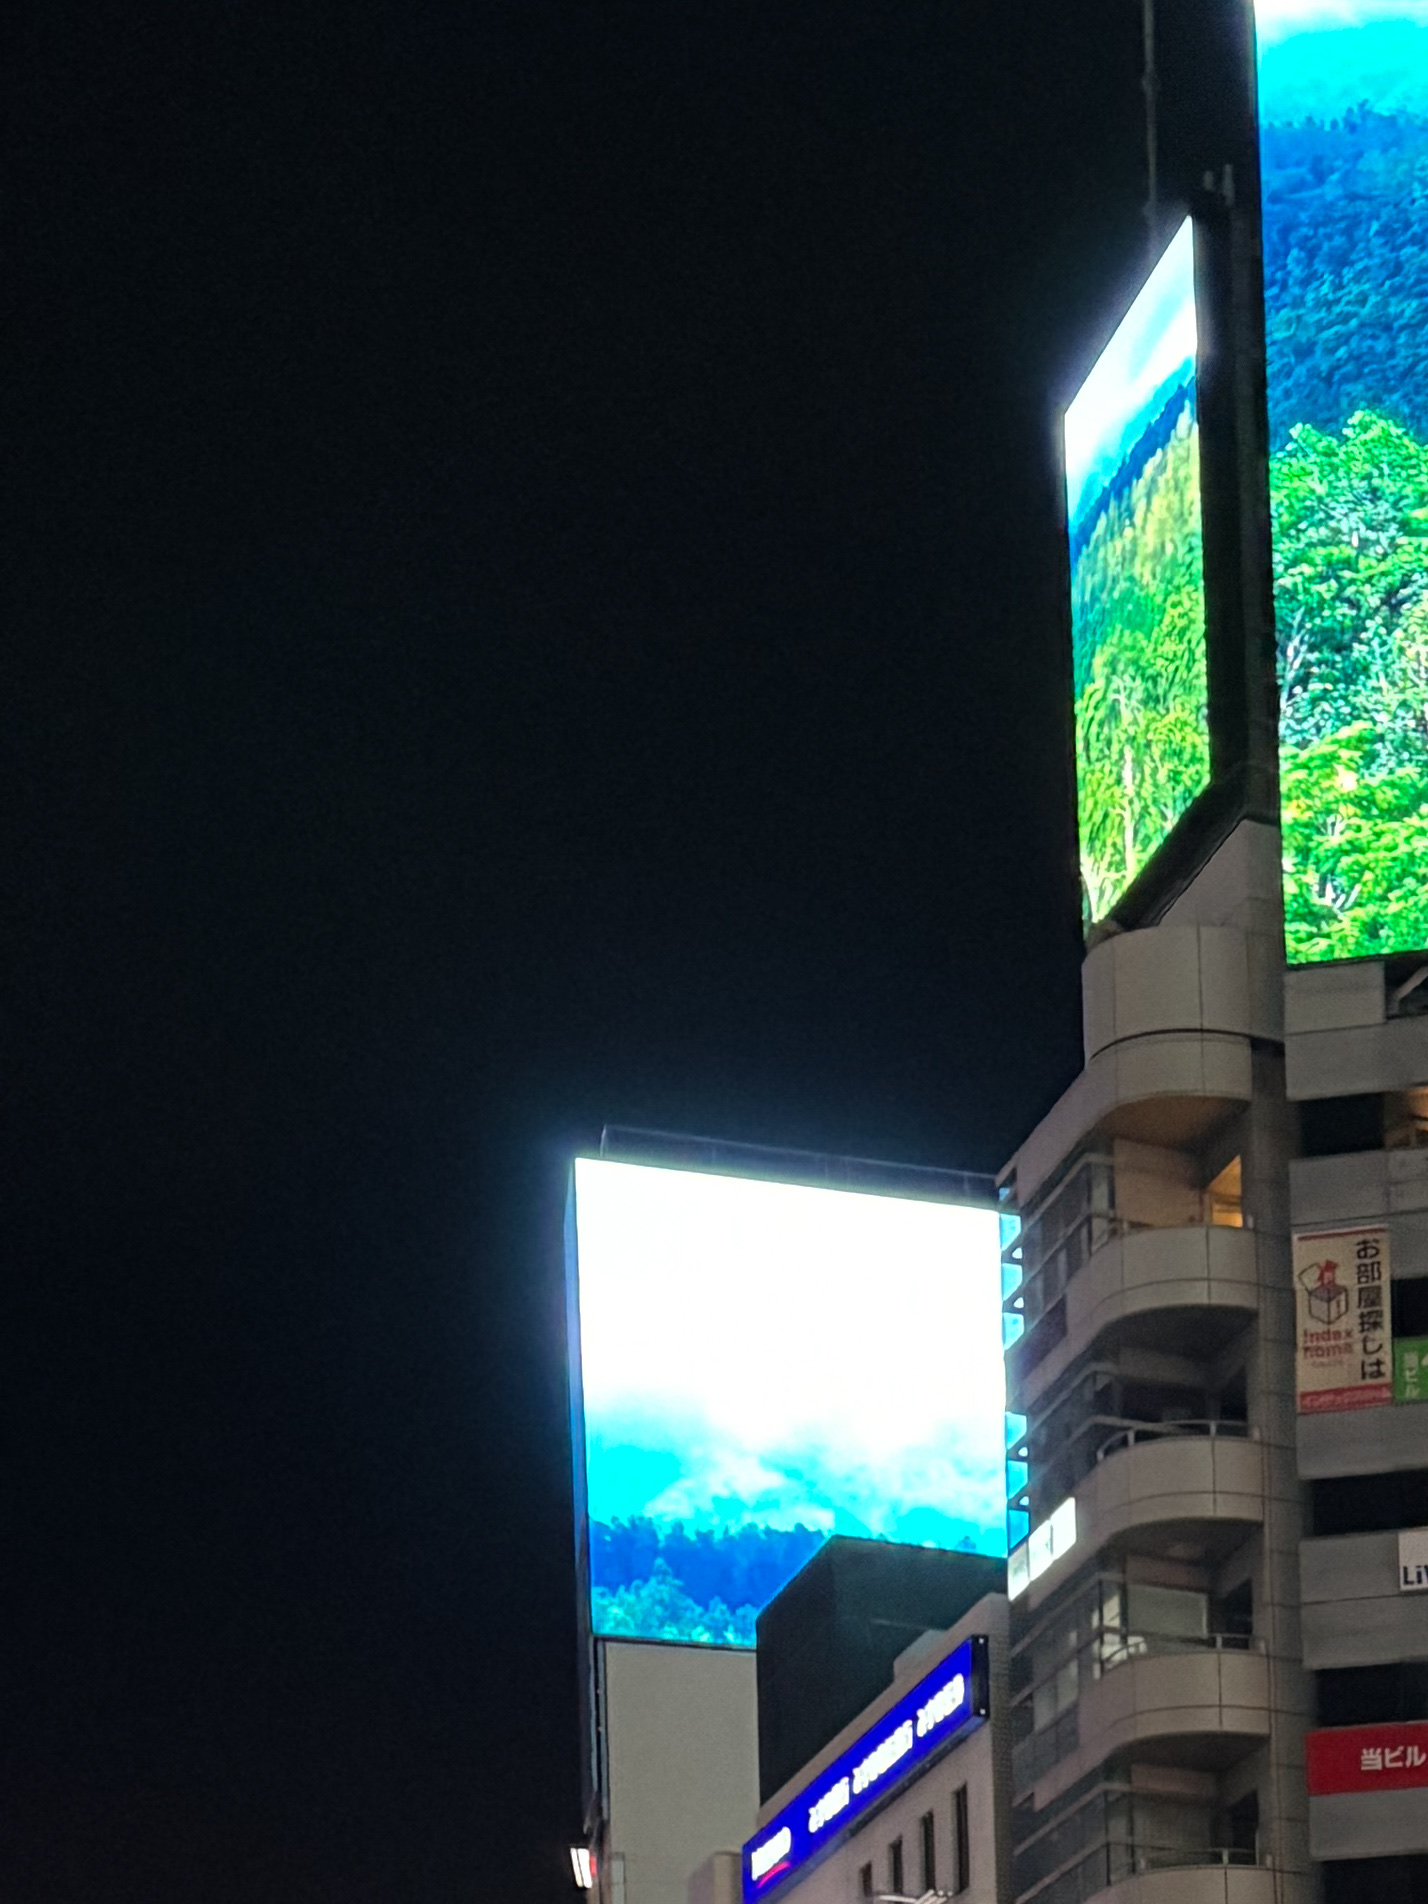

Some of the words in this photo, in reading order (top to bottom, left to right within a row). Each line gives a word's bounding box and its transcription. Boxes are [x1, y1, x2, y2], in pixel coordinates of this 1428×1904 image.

[1356, 1238, 1386, 1381] お部屋探しは
[1359, 1744, 1427, 1772] 当ビル
